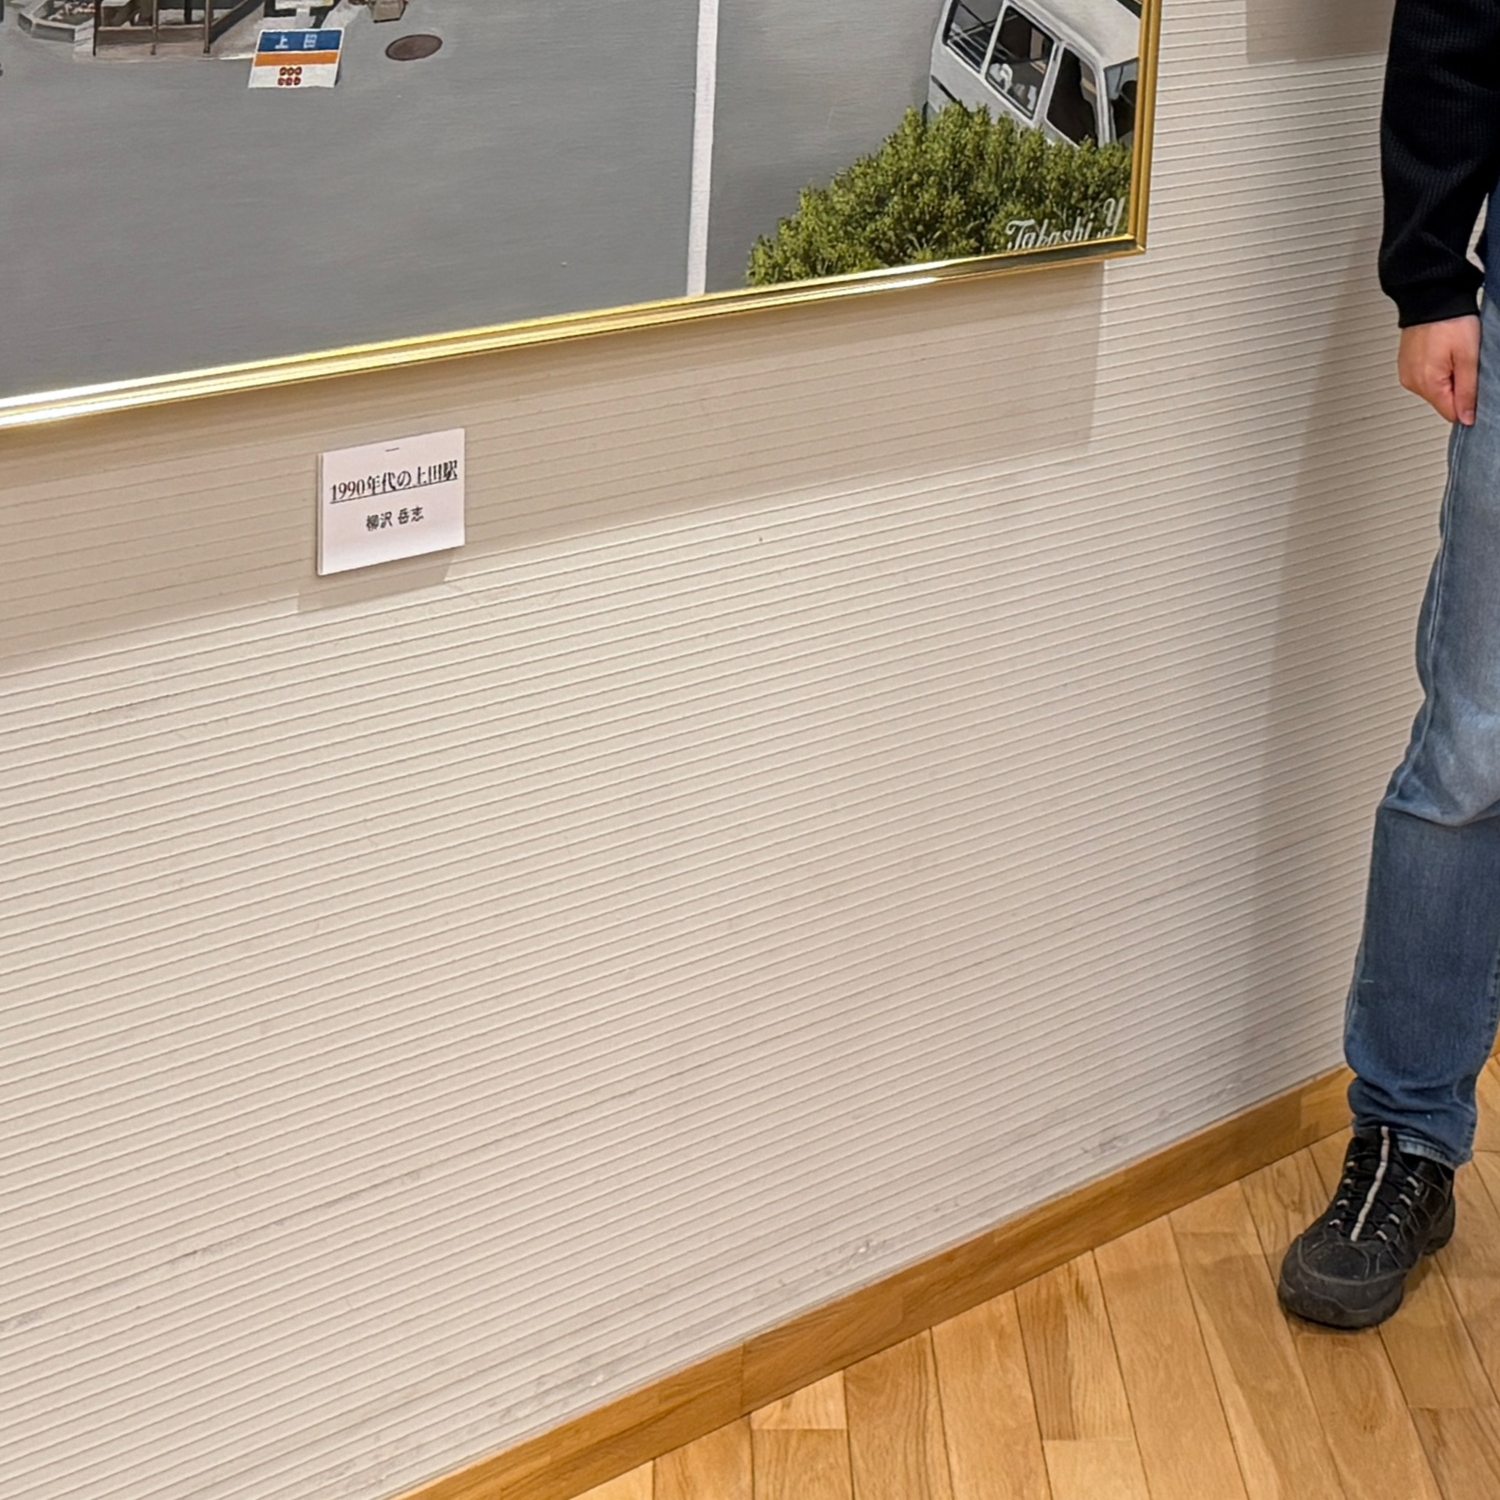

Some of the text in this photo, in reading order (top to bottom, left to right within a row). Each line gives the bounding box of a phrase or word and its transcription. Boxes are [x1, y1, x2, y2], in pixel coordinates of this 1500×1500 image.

[329, 459, 458, 502] 1990年代の上田駅
